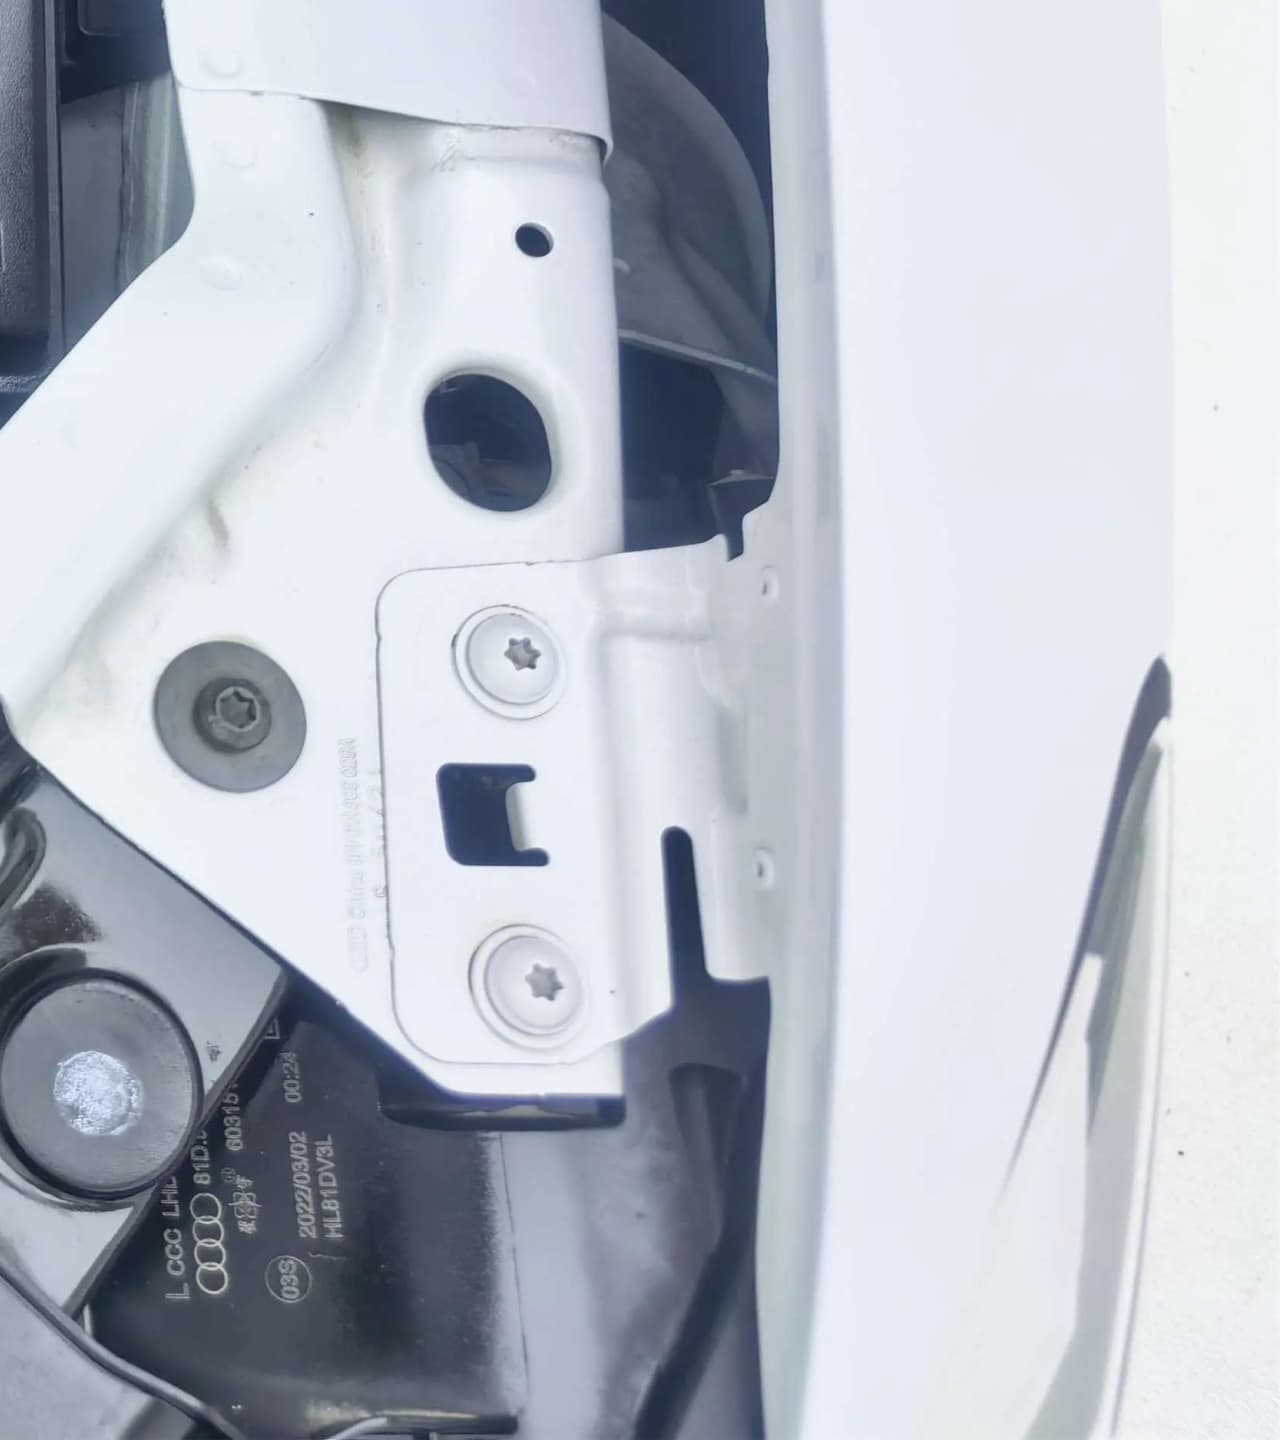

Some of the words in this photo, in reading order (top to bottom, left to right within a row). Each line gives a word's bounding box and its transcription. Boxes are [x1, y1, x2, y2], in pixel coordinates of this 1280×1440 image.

[280, 1050, 302, 1103] 00:24
[288, 1131, 318, 1239] 2022/03/02
[163, 1227, 185, 1276] CCC
